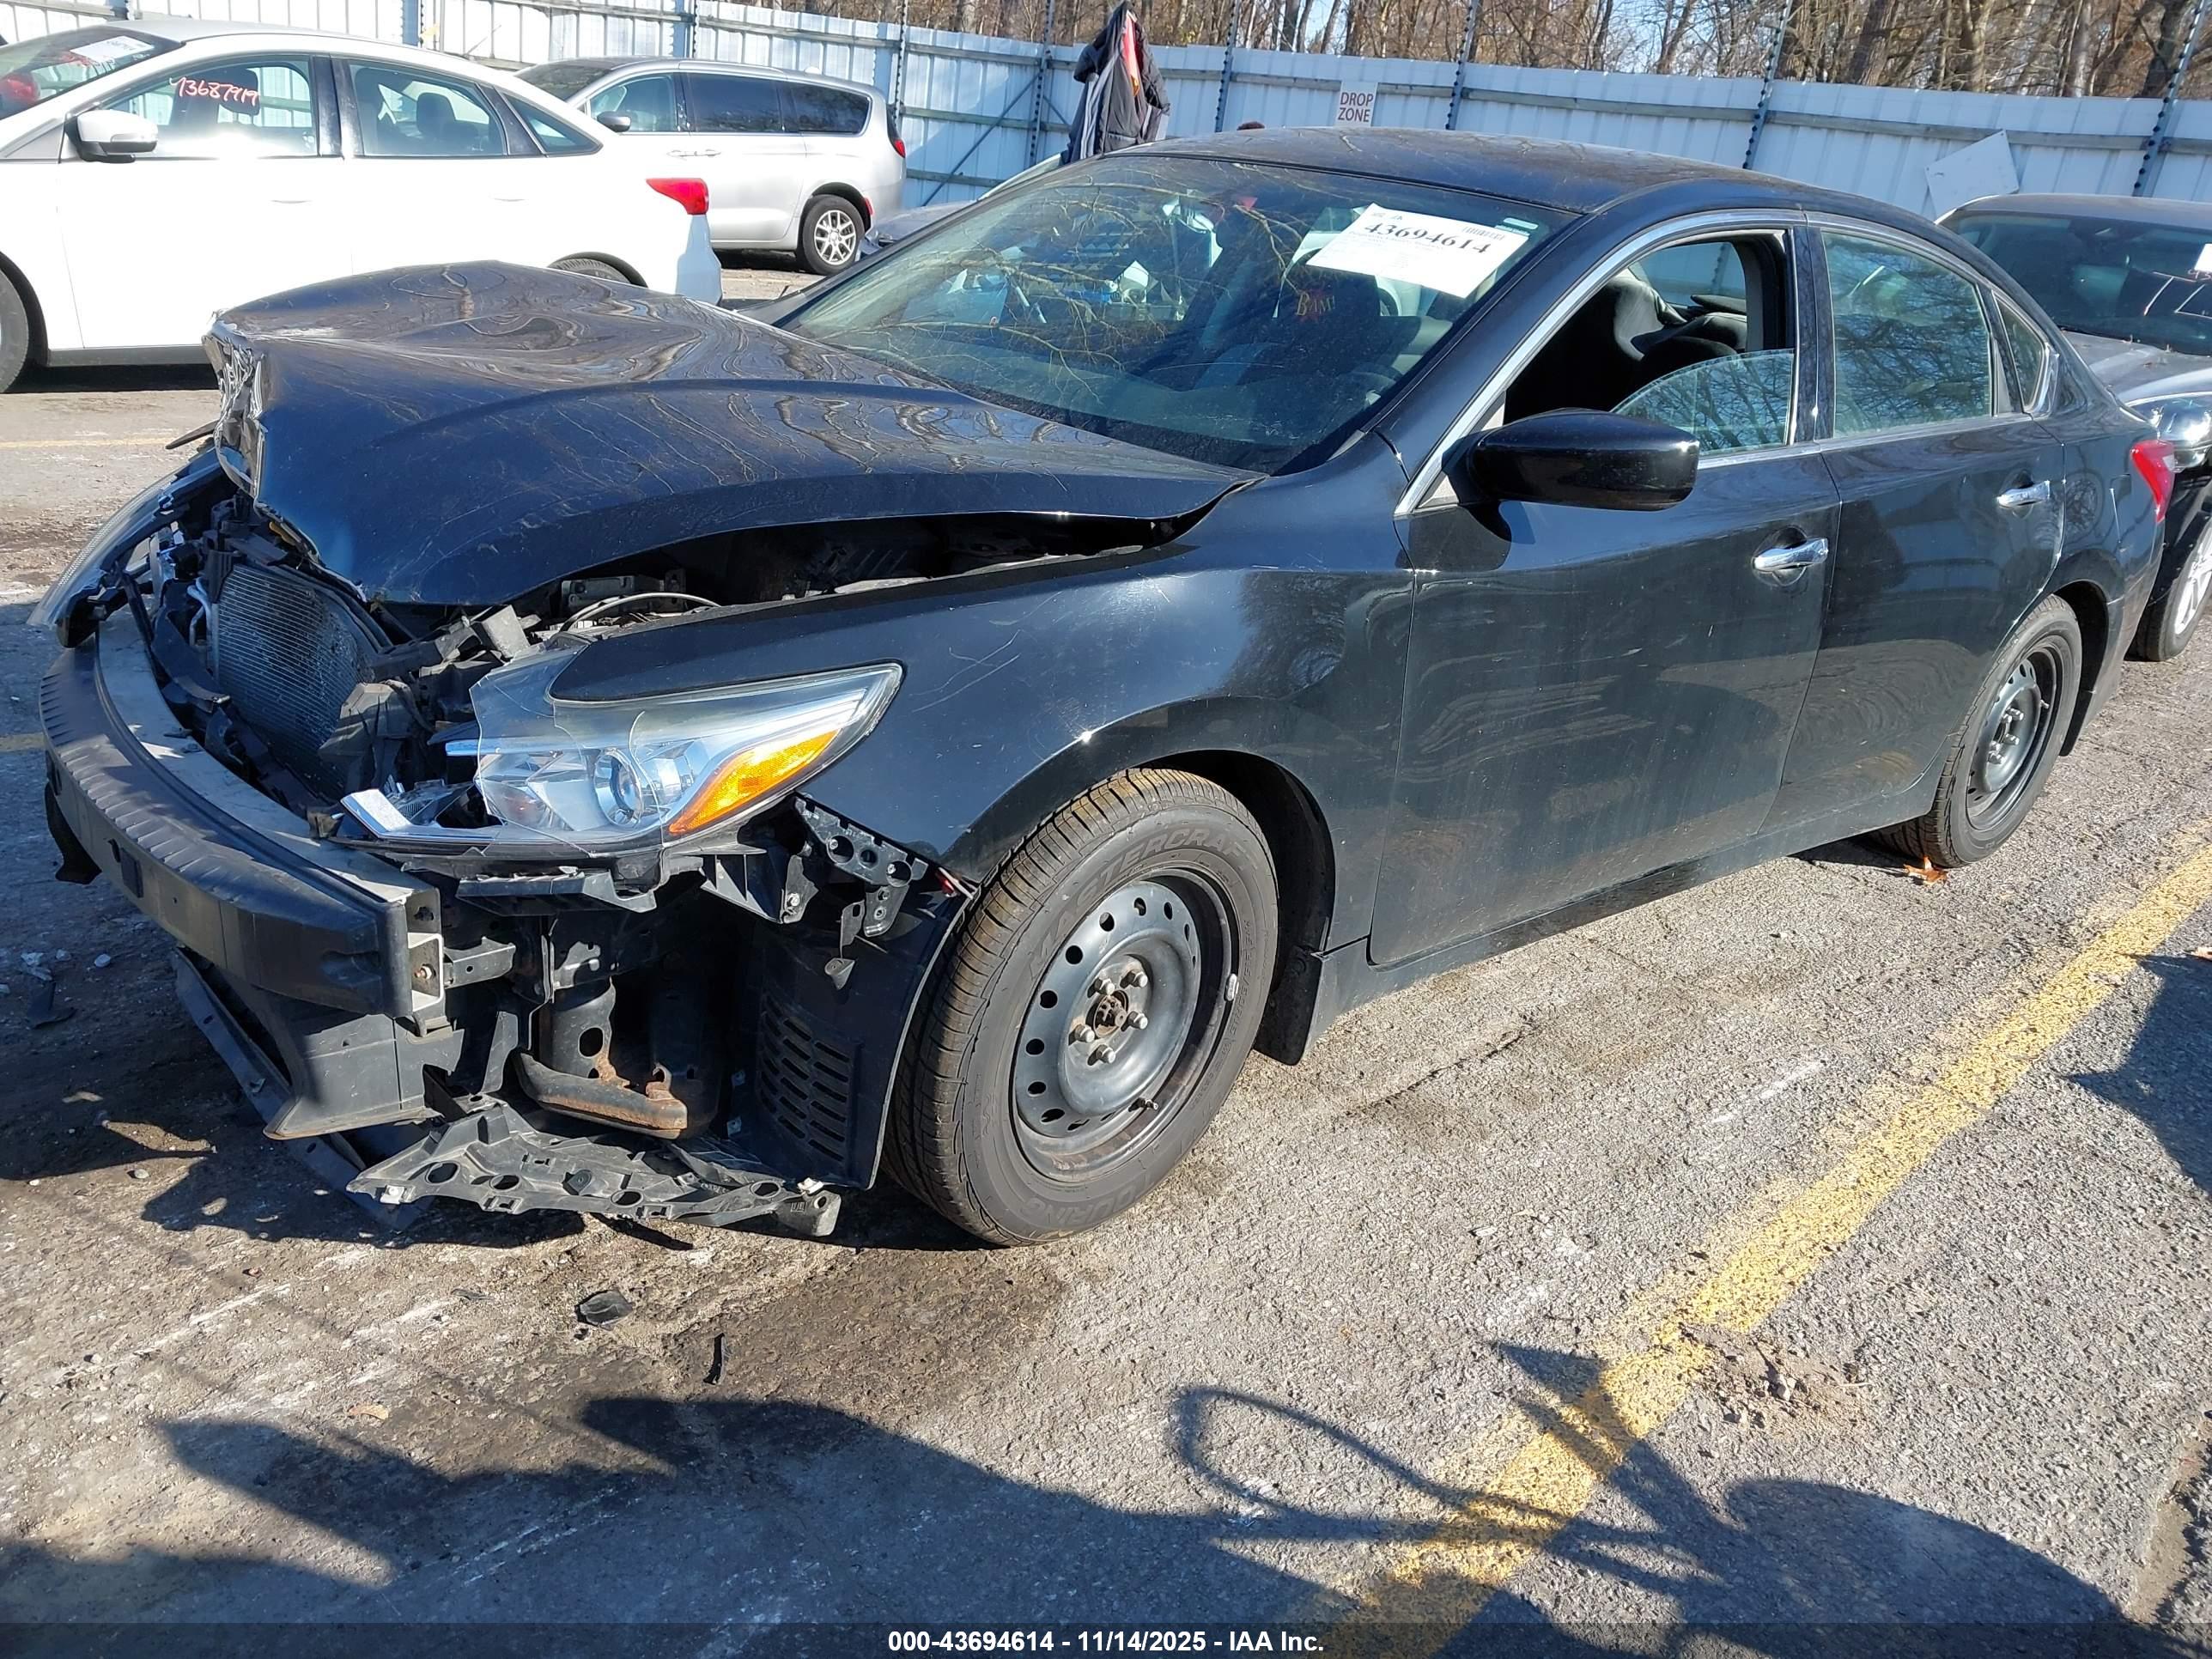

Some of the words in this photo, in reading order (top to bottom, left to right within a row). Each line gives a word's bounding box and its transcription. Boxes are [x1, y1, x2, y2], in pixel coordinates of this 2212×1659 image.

[1340, 92, 1374, 106] DROP
[1338, 107, 1371, 123] ZONE
[1364, 222, 1492, 253] 43694614
[1018, 1172, 1157, 1225] TOURING
